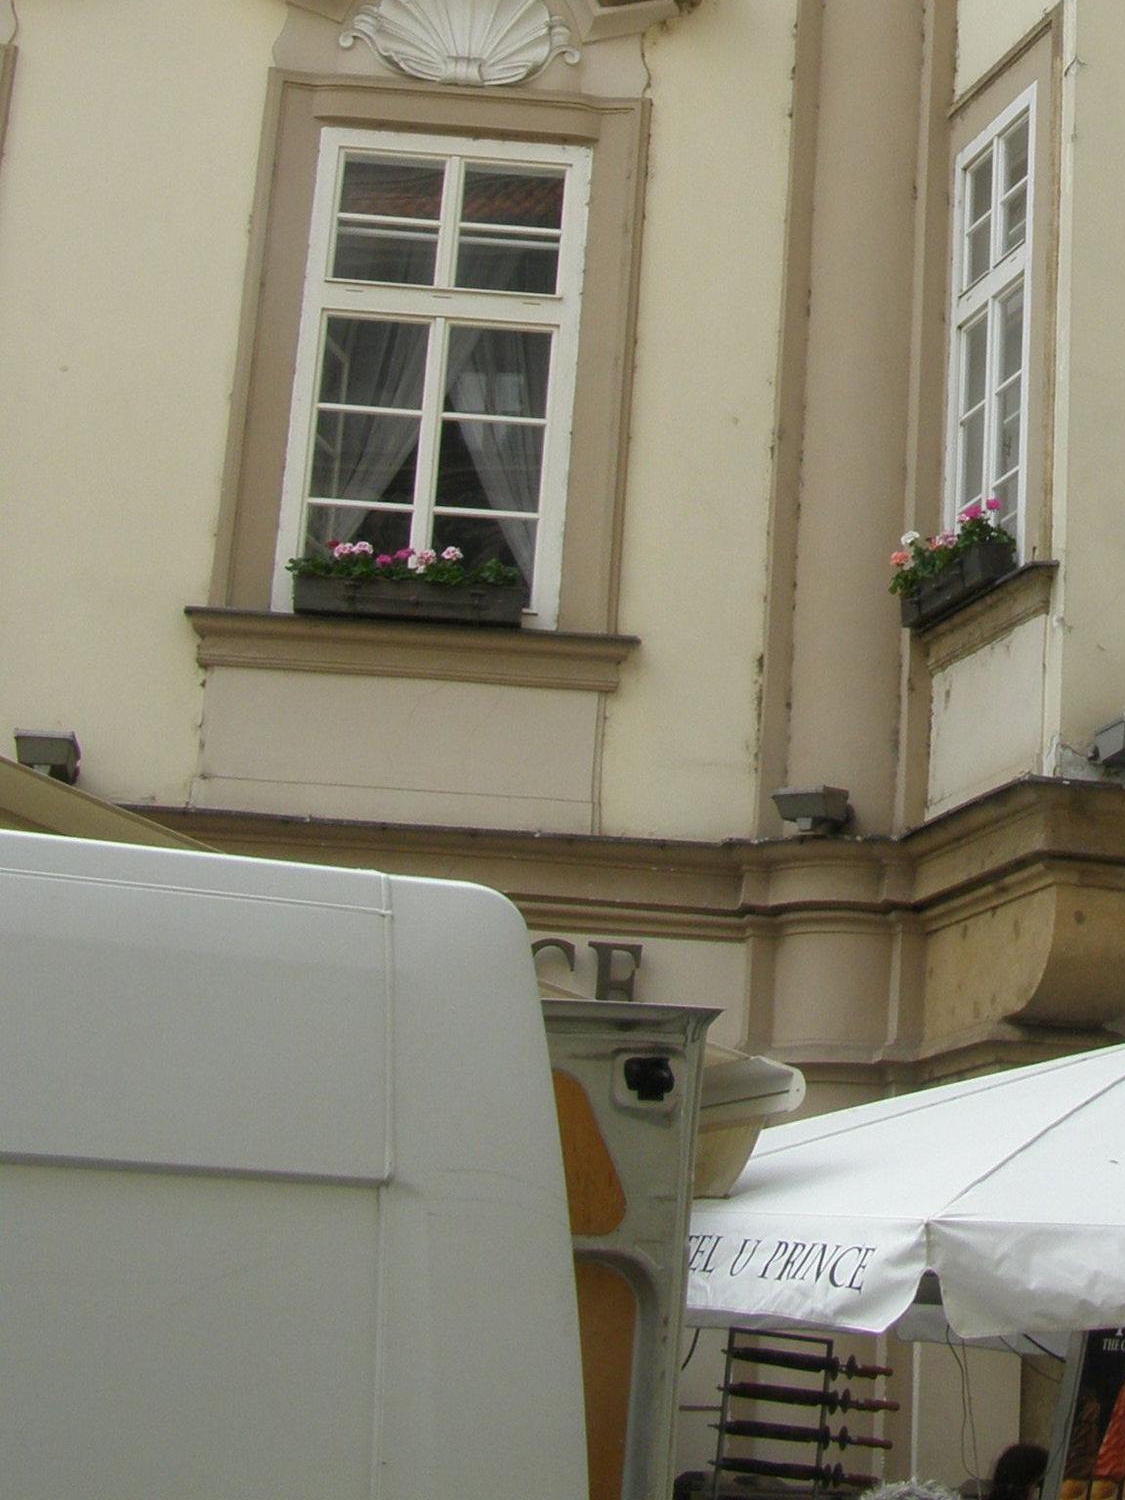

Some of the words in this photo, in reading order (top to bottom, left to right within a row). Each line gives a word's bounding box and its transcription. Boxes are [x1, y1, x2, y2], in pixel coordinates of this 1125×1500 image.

[729, 1238, 761, 1277] U
[757, 1240, 877, 1295] PRINCE
[1102, 1338, 1120, 1351] THE
